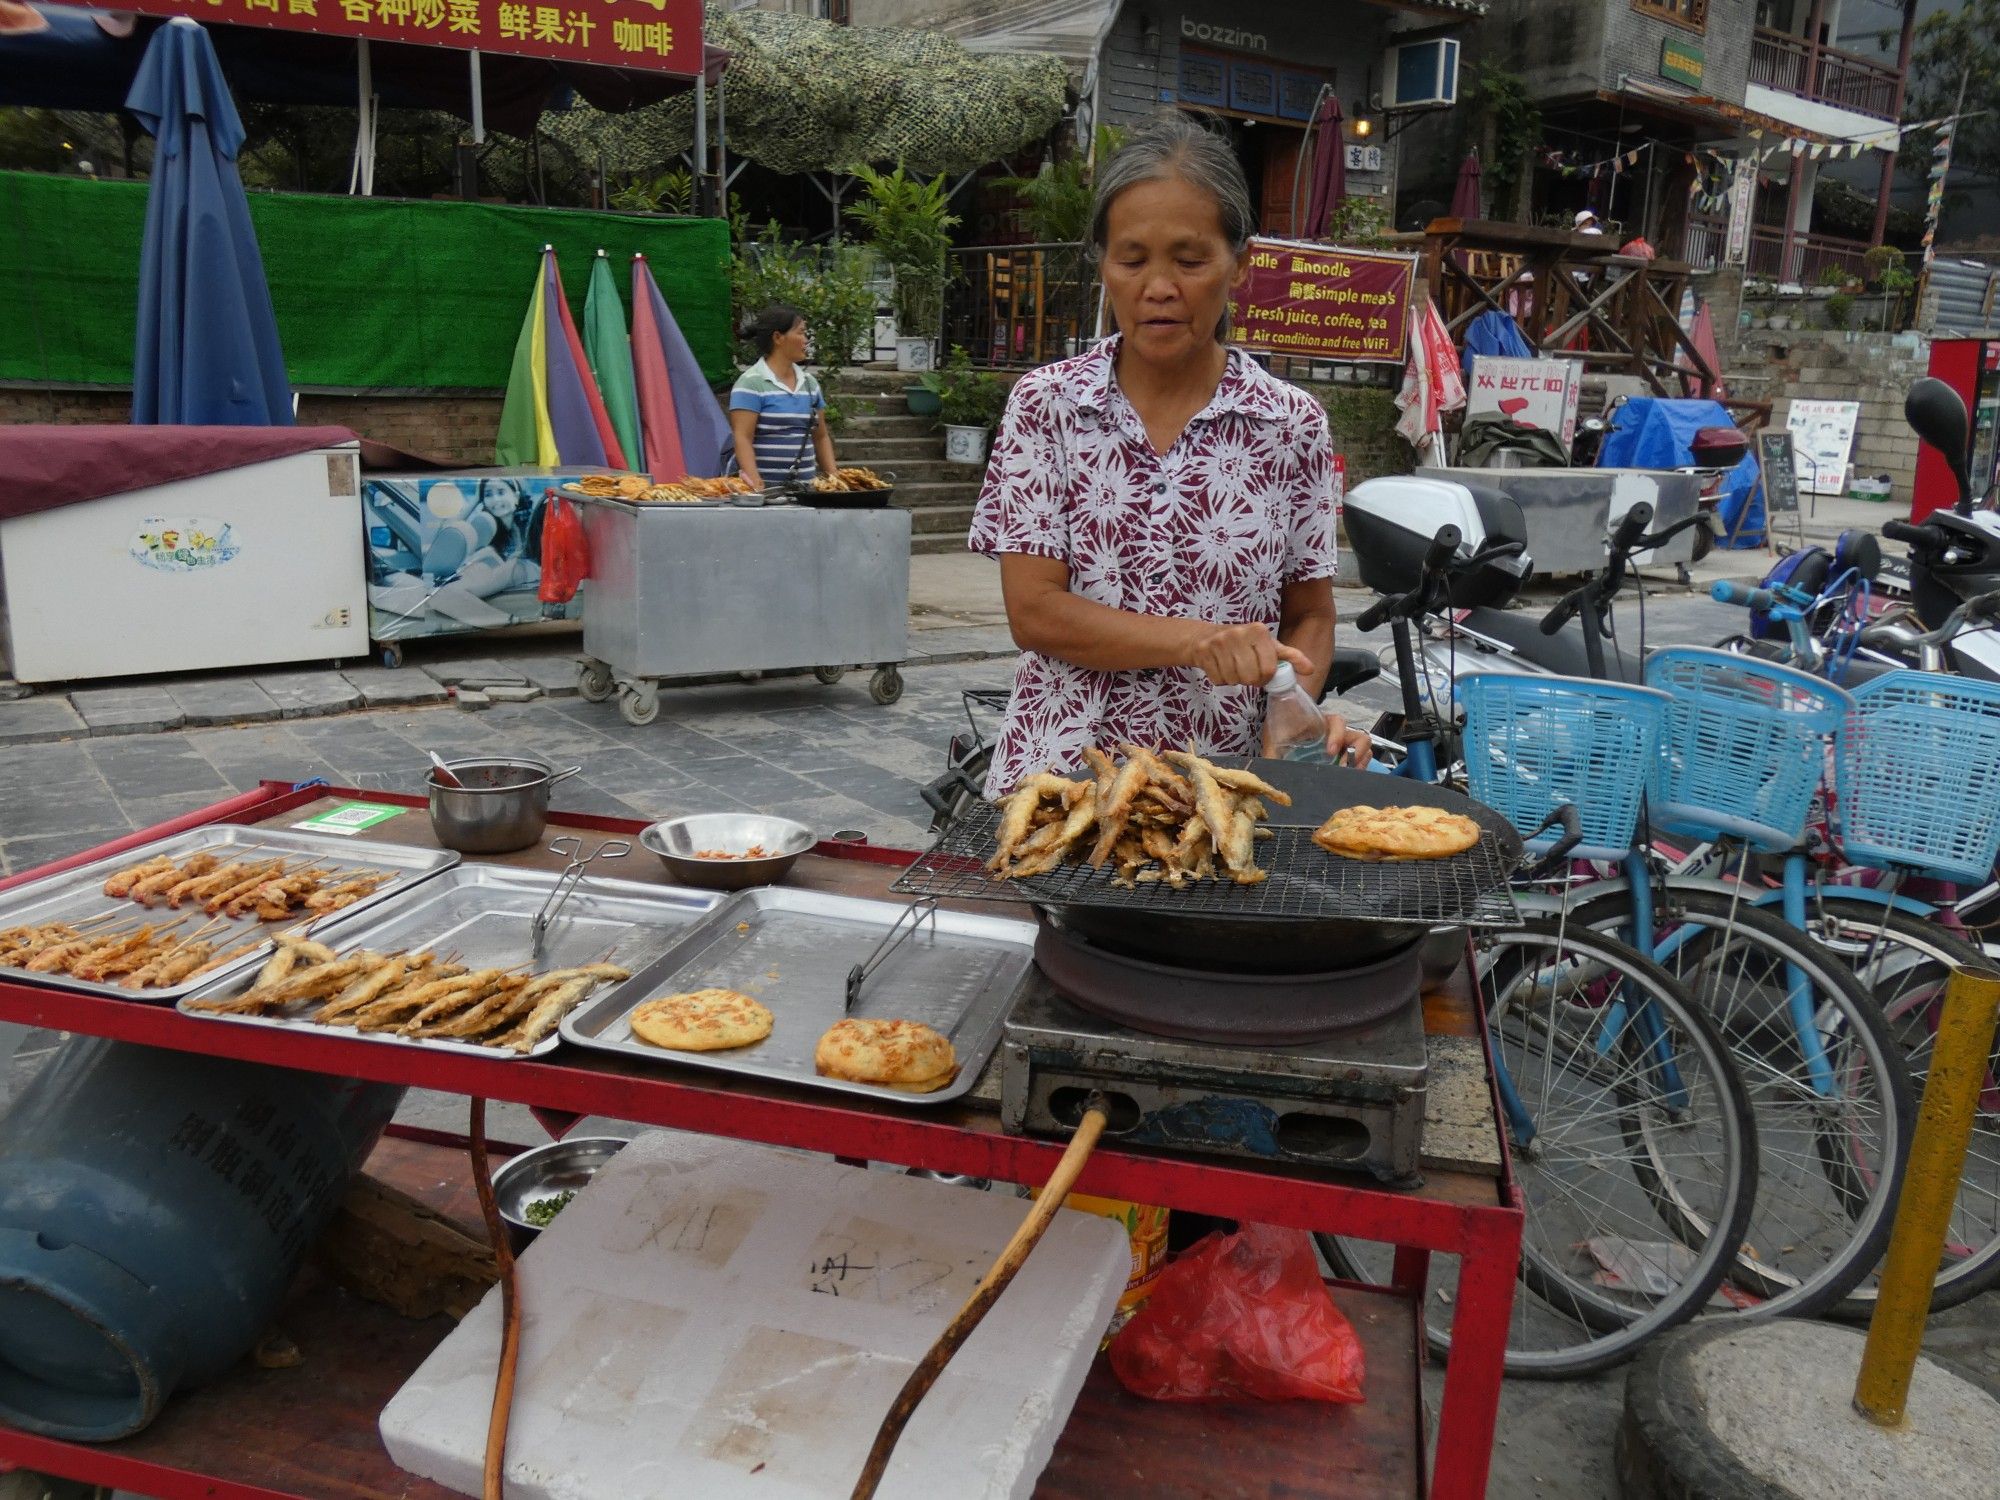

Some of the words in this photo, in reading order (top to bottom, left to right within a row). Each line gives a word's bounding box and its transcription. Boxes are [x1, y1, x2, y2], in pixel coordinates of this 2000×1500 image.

[339, 0, 481, 35] 各种炒菜
[498, 3, 596, 48] 鲜果汁
[612, 18, 674, 56] 咖啡
[1181, 14, 1267, 51] bozzinn
[1247, 304, 1284, 321] Fresh
[1285, 308, 1321, 327] juice,
[1324, 312, 1364, 331] coffee,
[1252, 328, 1271, 342] Air
[1271, 332, 1320, 346] condition
[1321, 336, 1341, 348] and
[1342, 336, 1361, 349] free
[1362, 337, 1389, 350] WiFi
